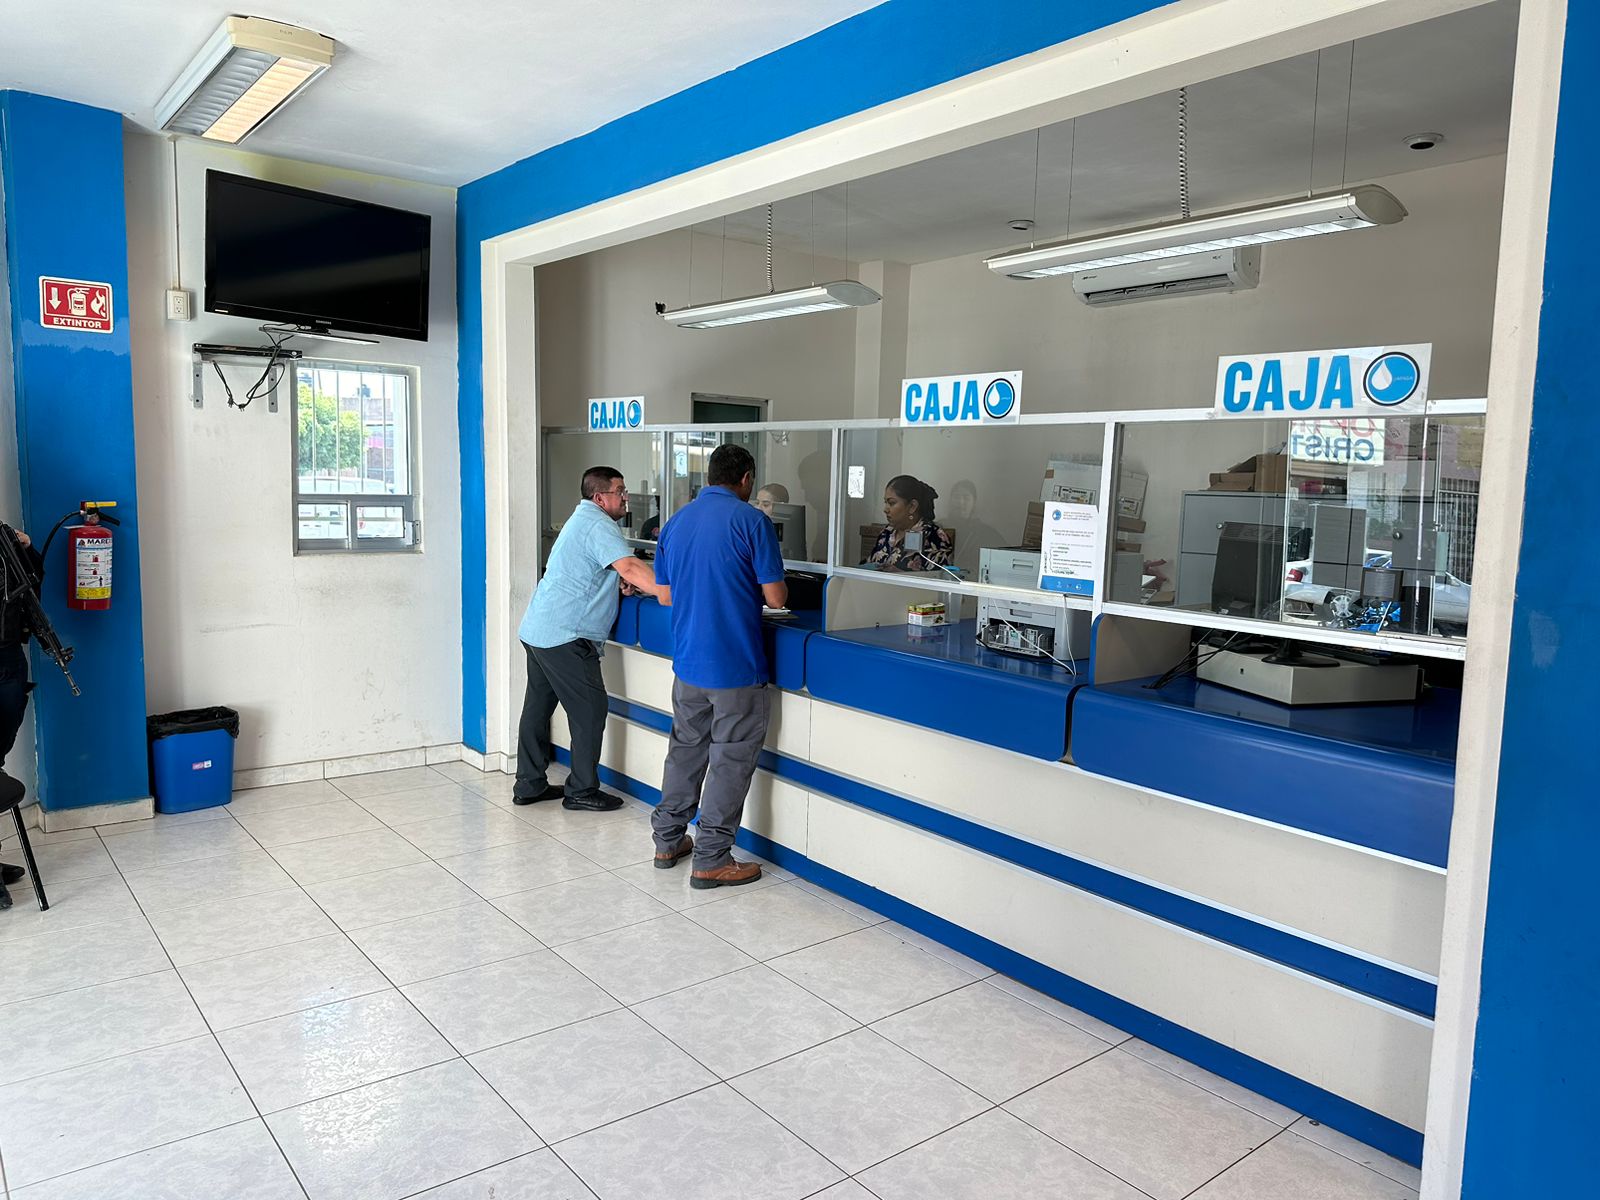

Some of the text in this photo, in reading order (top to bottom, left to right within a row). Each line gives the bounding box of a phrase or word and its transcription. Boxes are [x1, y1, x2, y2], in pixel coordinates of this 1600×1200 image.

[53, 317, 102, 329] EXTINTOR
[905, 380, 980, 422] CAJA
[1223, 355, 1354, 413] CAJA
[590, 401, 627, 429] CAJA
